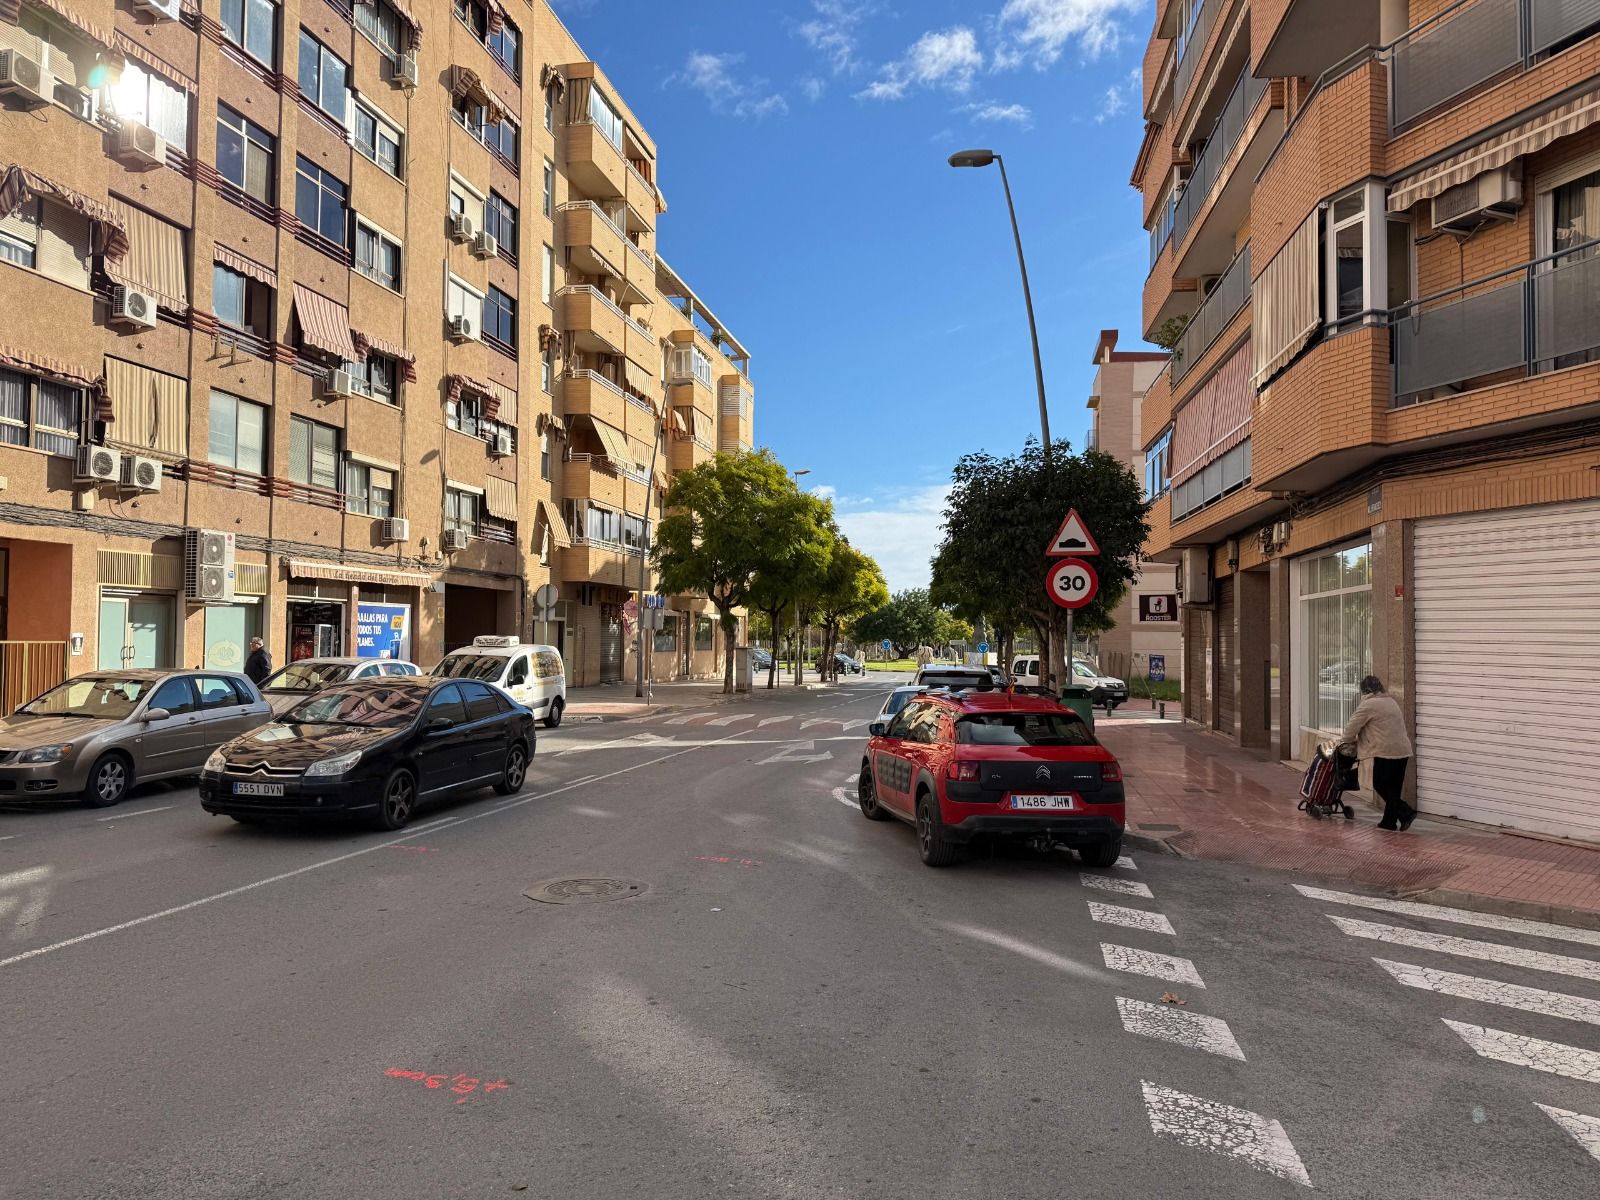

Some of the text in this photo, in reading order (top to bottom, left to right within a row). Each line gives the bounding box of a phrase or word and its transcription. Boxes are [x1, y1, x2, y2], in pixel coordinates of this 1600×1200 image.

[367, 573, 377, 582] del
[1059, 575, 1086, 591] 30
[238, 783, 282, 795] 5551 DVN
[1020, 797, 1070, 808] 1486 JHW
